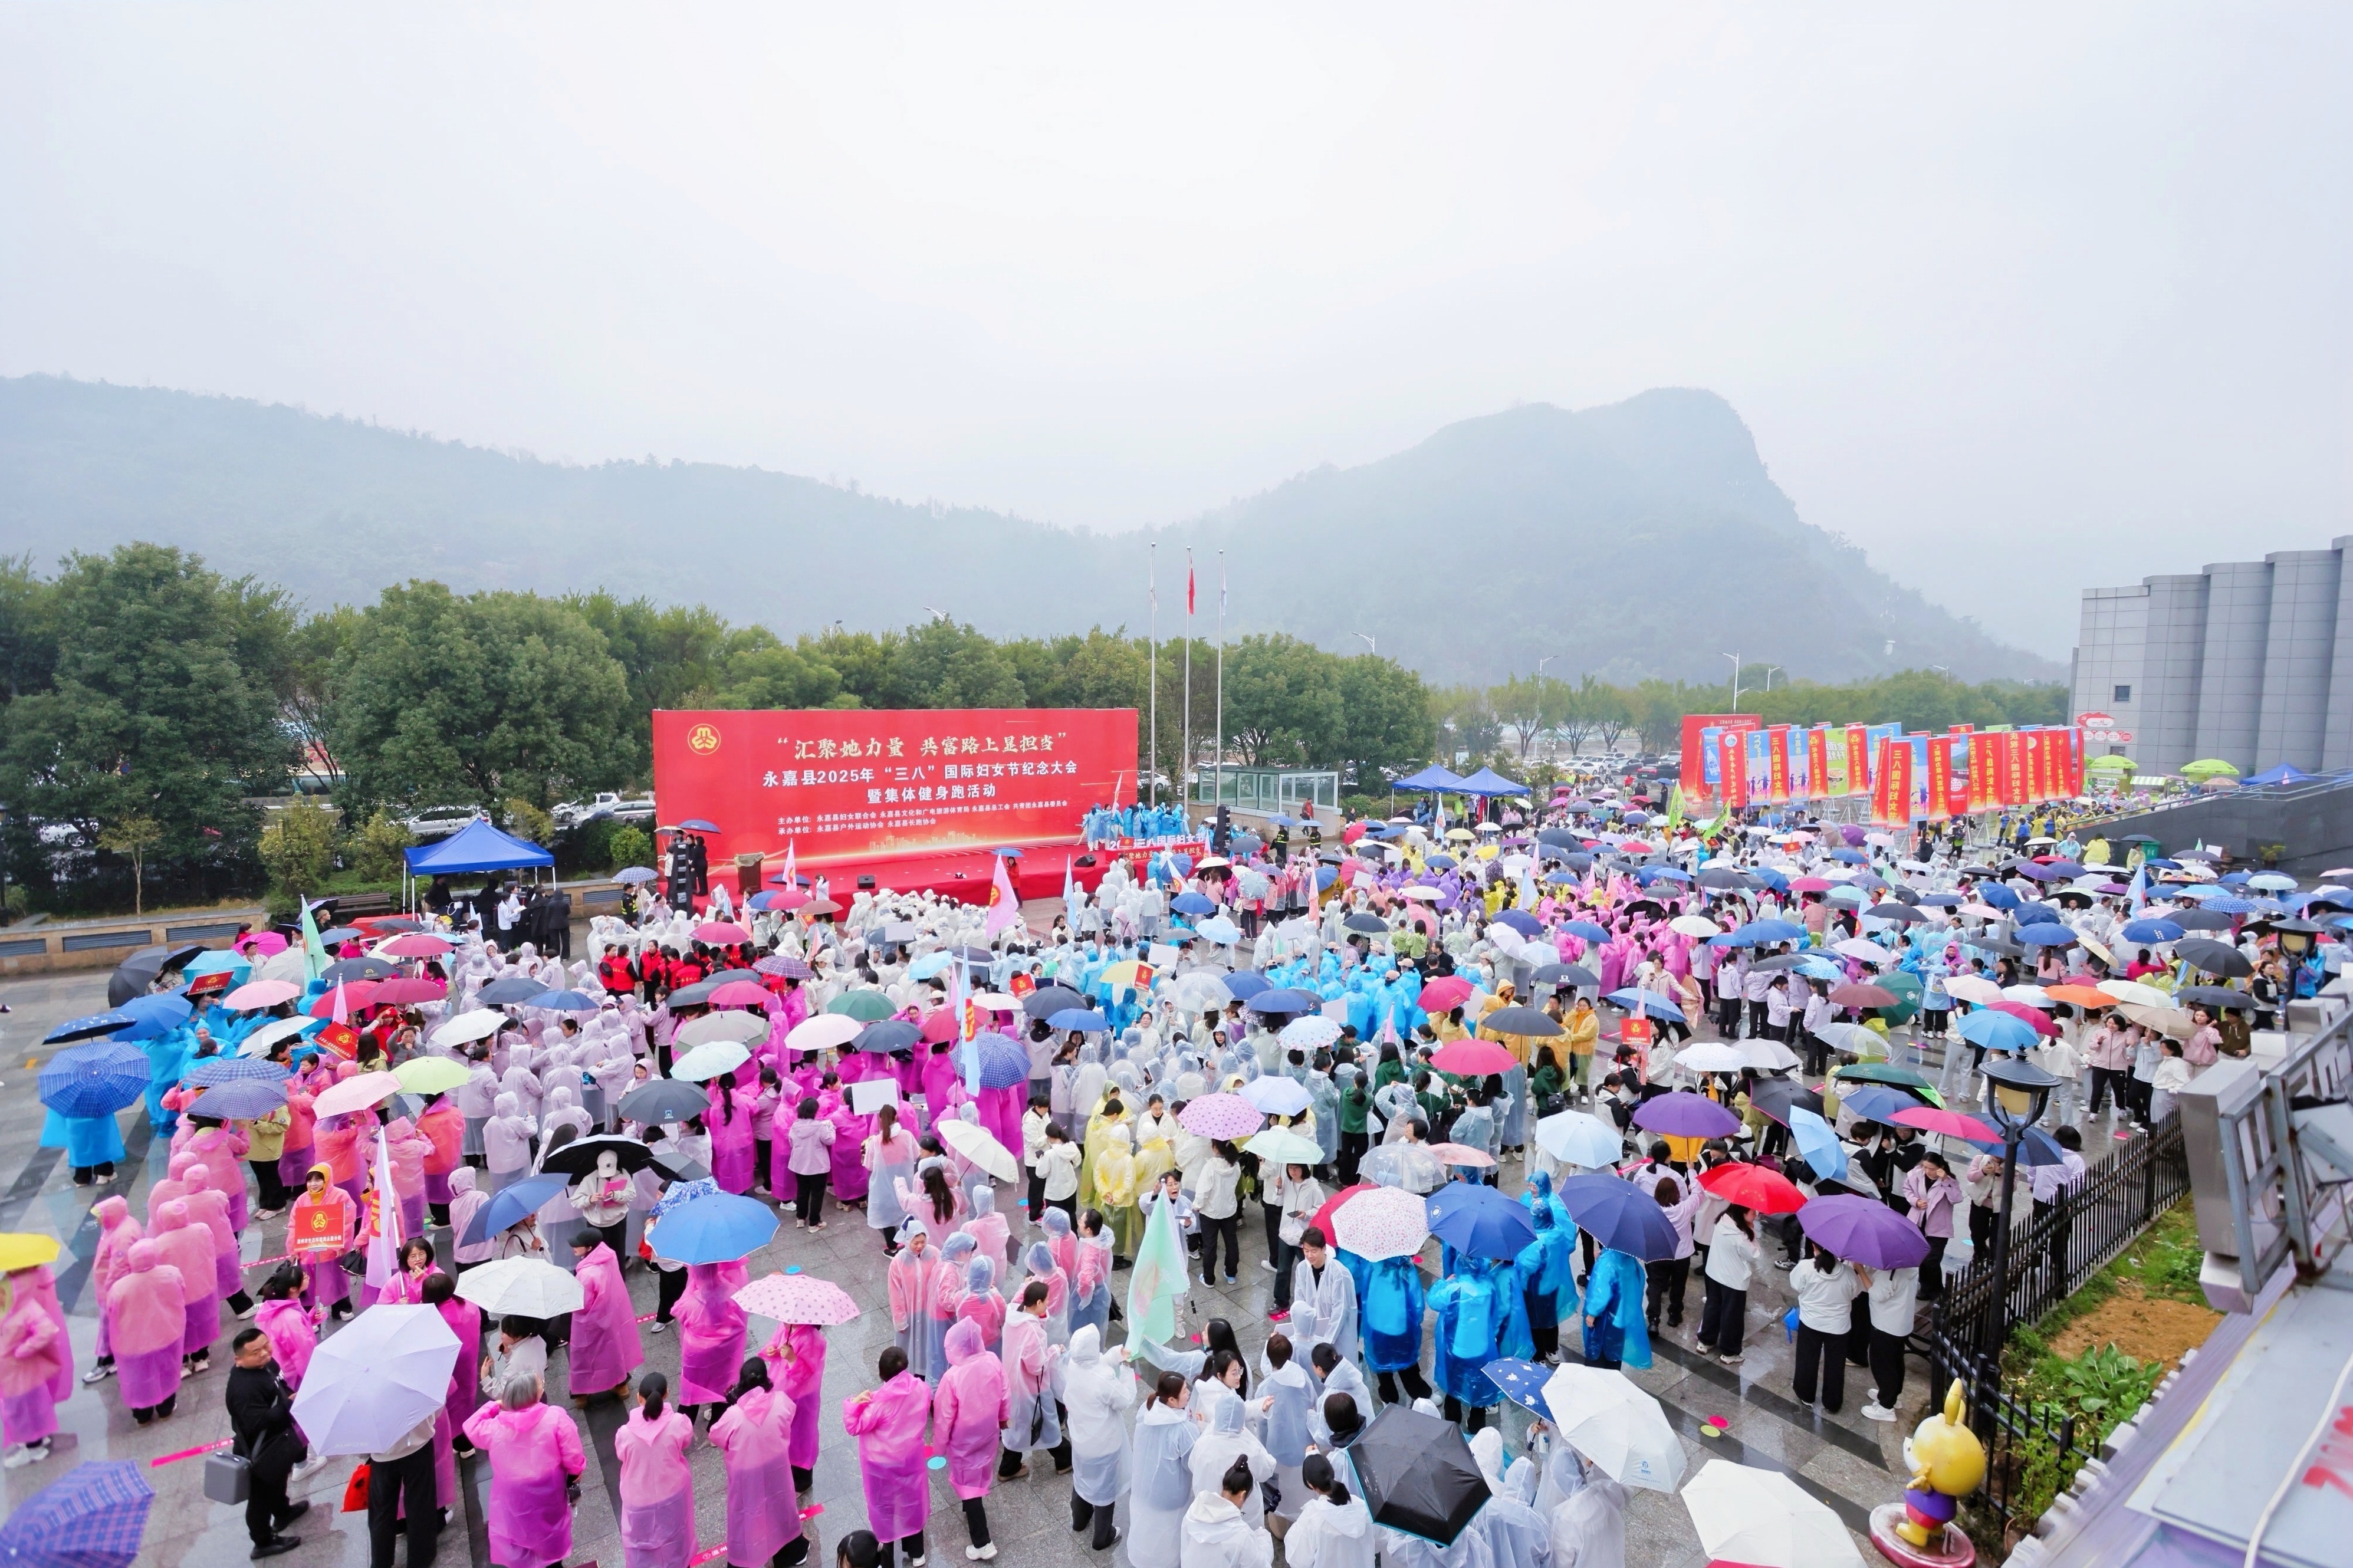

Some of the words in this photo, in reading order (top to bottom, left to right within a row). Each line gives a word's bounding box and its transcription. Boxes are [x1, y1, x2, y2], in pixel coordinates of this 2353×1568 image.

[777, 737, 904, 760] “汇聚她力量
[919, 732, 1066, 757] 共富路上显担当”
[763, 760, 1077, 787] 永嘉县2025年“三八”国际妇女节纪念大会
[867, 783, 995, 804] 暨集体健身跑活动
[816, 811, 876, 823] 永嘉县妇女联合会
[879, 805, 970, 818] 永嘉县文化和广电旅游体育局
[971, 803, 1010, 813] 永嘉县总工会
[1013, 800, 1068, 810] 共青团永嘉县委员会
[817, 821, 884, 833] 永嘉县户外运动协会
[887, 817, 936, 828] 永嘉县长跑协会
